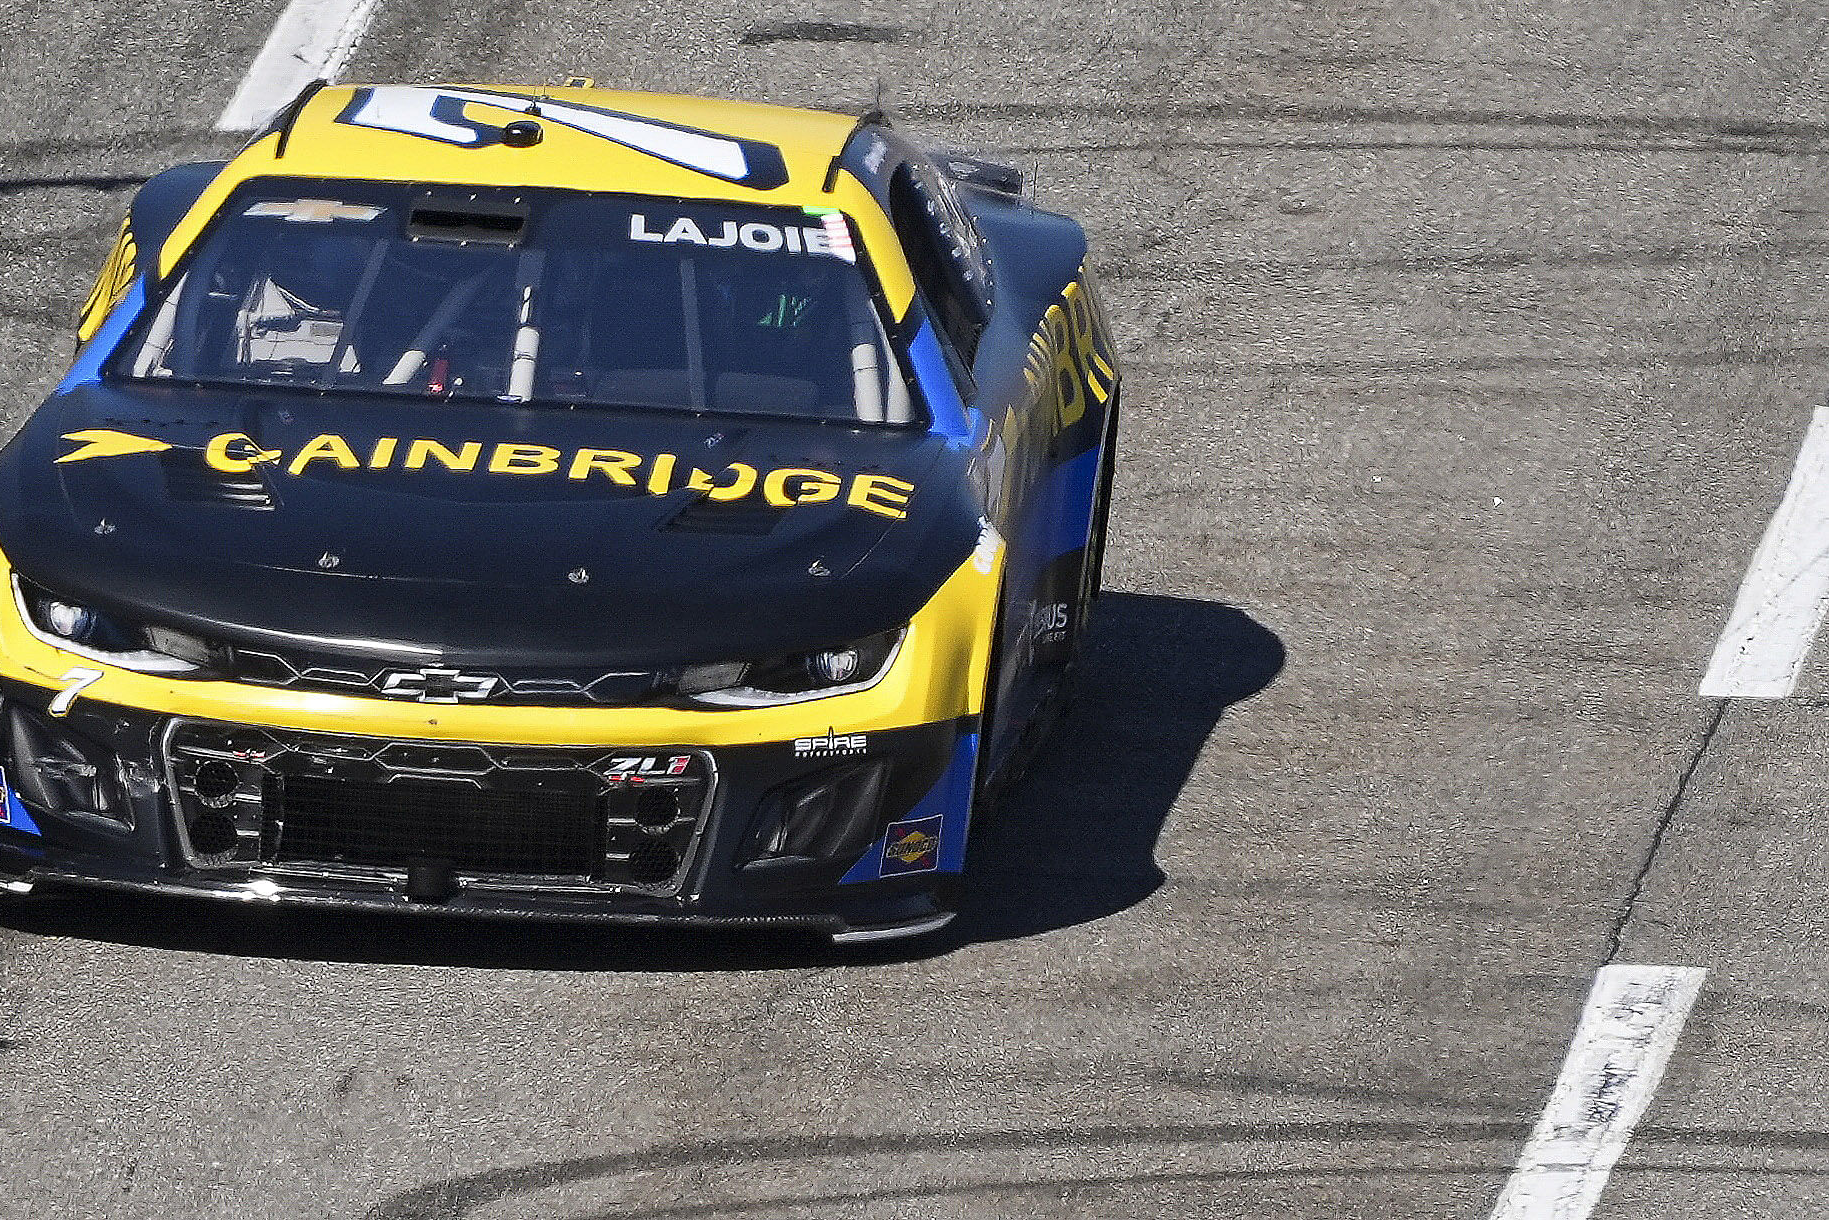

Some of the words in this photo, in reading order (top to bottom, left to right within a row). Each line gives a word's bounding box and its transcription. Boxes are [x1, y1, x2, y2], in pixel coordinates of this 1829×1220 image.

[336, 85, 789, 191] 7
[630, 214, 834, 255] LAJOIE
[203, 431, 916, 520] GAINBRIDGE
[48, 666, 105, 717] 7
[794, 725, 867, 751] SPIRE
[602, 754, 691, 775] ZL1
